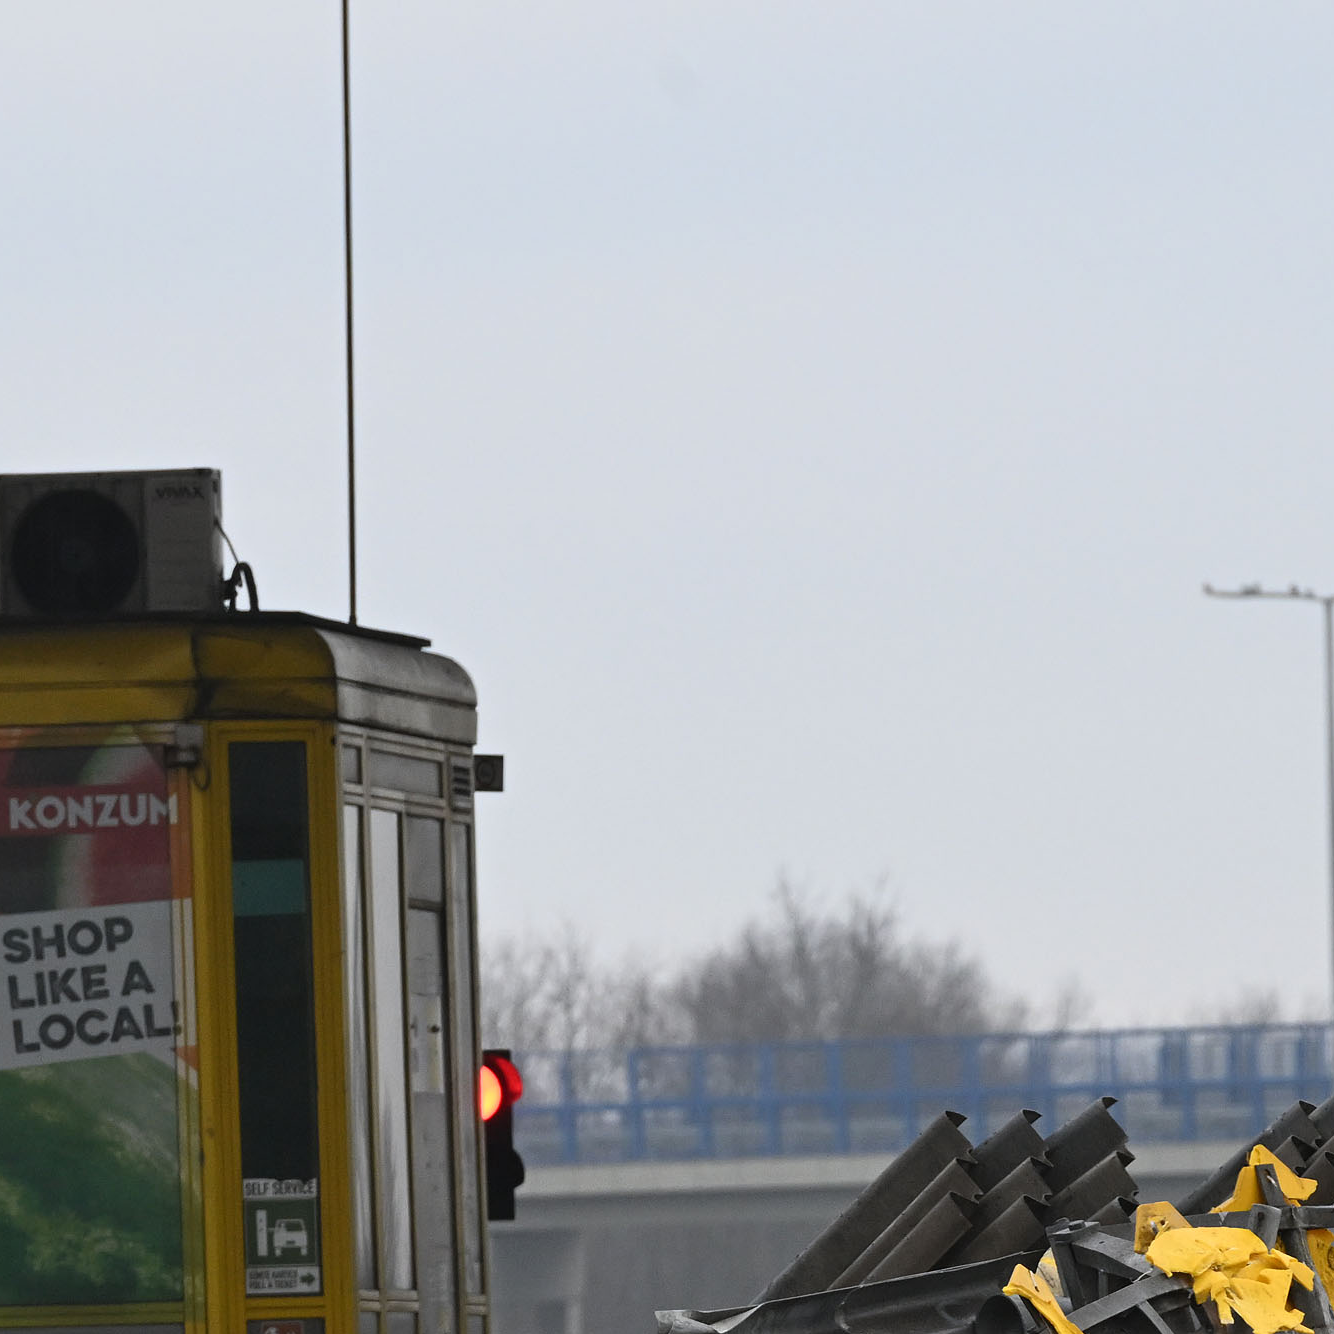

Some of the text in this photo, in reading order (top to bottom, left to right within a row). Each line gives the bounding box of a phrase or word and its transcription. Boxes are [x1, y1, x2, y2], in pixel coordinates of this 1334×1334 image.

[9, 792, 178, 829] KONZUM
[3, 916, 133, 964] SHOP
[8, 960, 156, 1010] LIKE A
[13, 1001, 182, 1054] LOCAL!
[245, 1179, 316, 1197] SELF SERVICE
